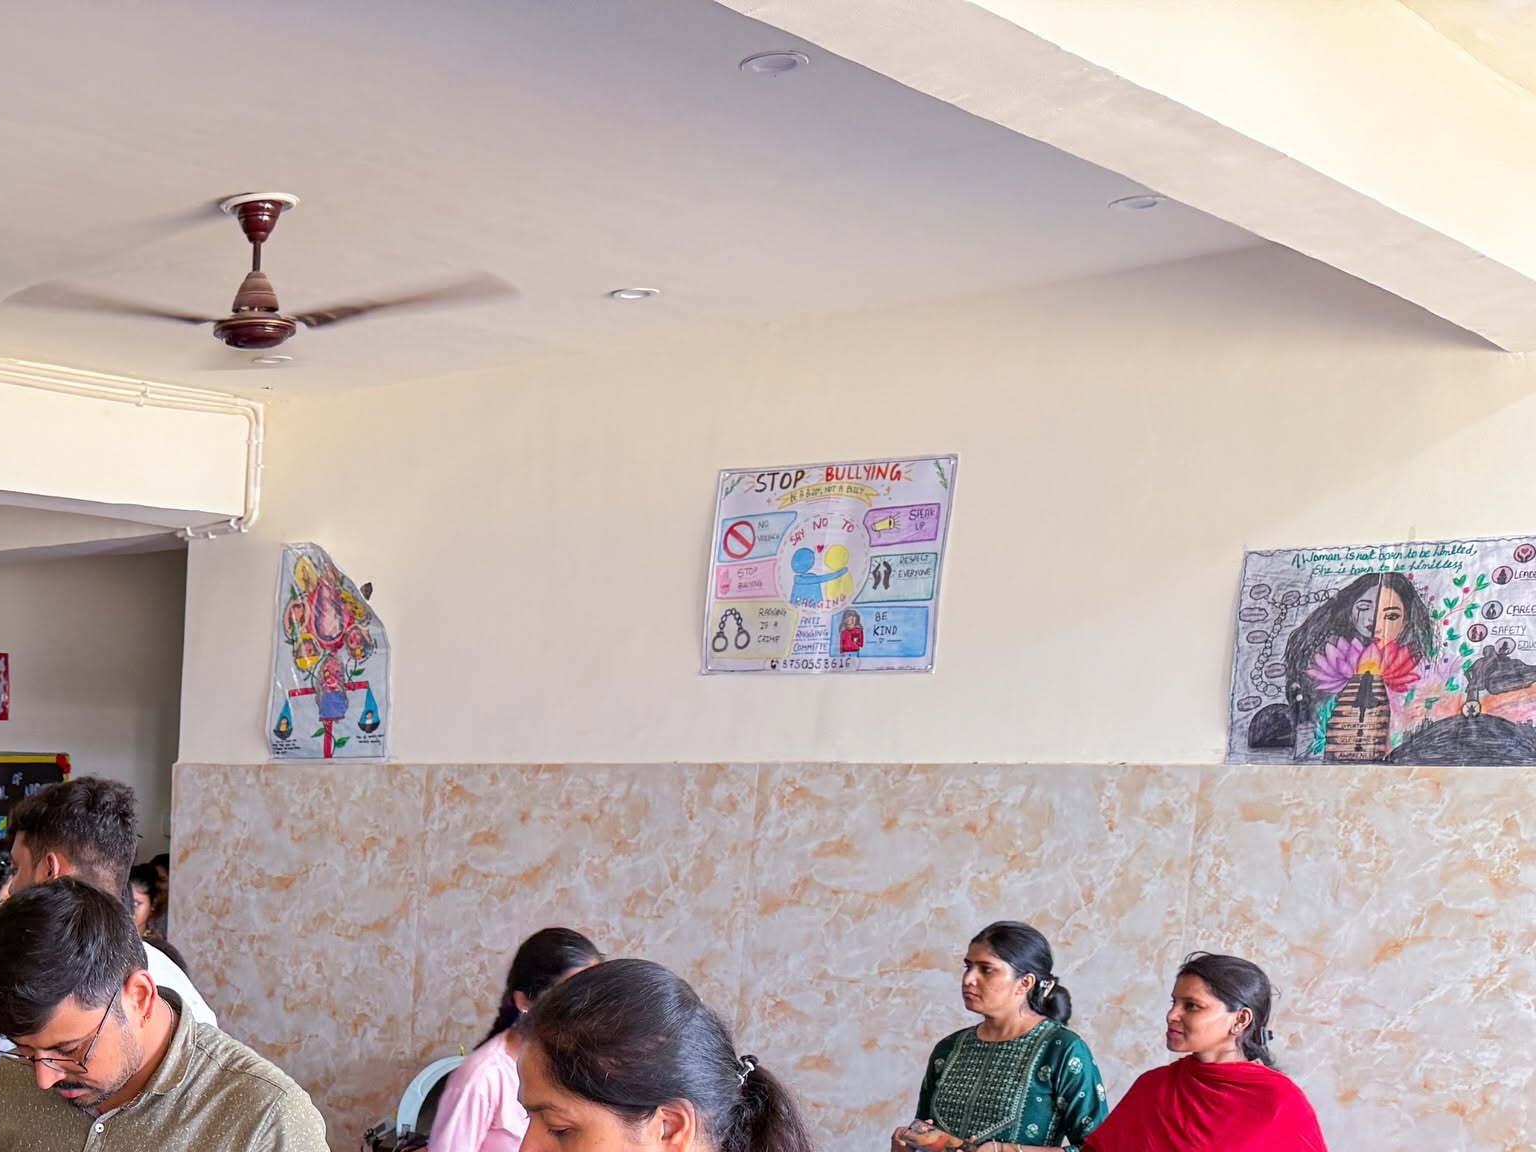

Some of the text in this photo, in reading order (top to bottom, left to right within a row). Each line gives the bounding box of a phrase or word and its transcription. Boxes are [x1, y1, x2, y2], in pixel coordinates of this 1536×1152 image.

[755, 463, 902, 493] STOP BULLYING
[909, 508, 936, 520] SPEAK
[758, 520, 768, 528] NO
[790, 517, 855, 546] SAY NO TO
[1302, 552, 1341, 564] Woman
[1346, 552, 1355, 560] is
[1356, 549, 1376, 560] not
[1379, 543, 1403, 560] born
[1405, 548, 1418, 559] to
[1419, 547, 1431, 558] be
[737, 566, 758, 578] STOP
[1312, 564, 1332, 575] She
[1351, 564, 1373, 575] born
[800, 616, 821, 625] ANTI
[875, 612, 888, 622] BE
[872, 624, 898, 637] KIND
[1492, 626, 1526, 635] SAFETY
